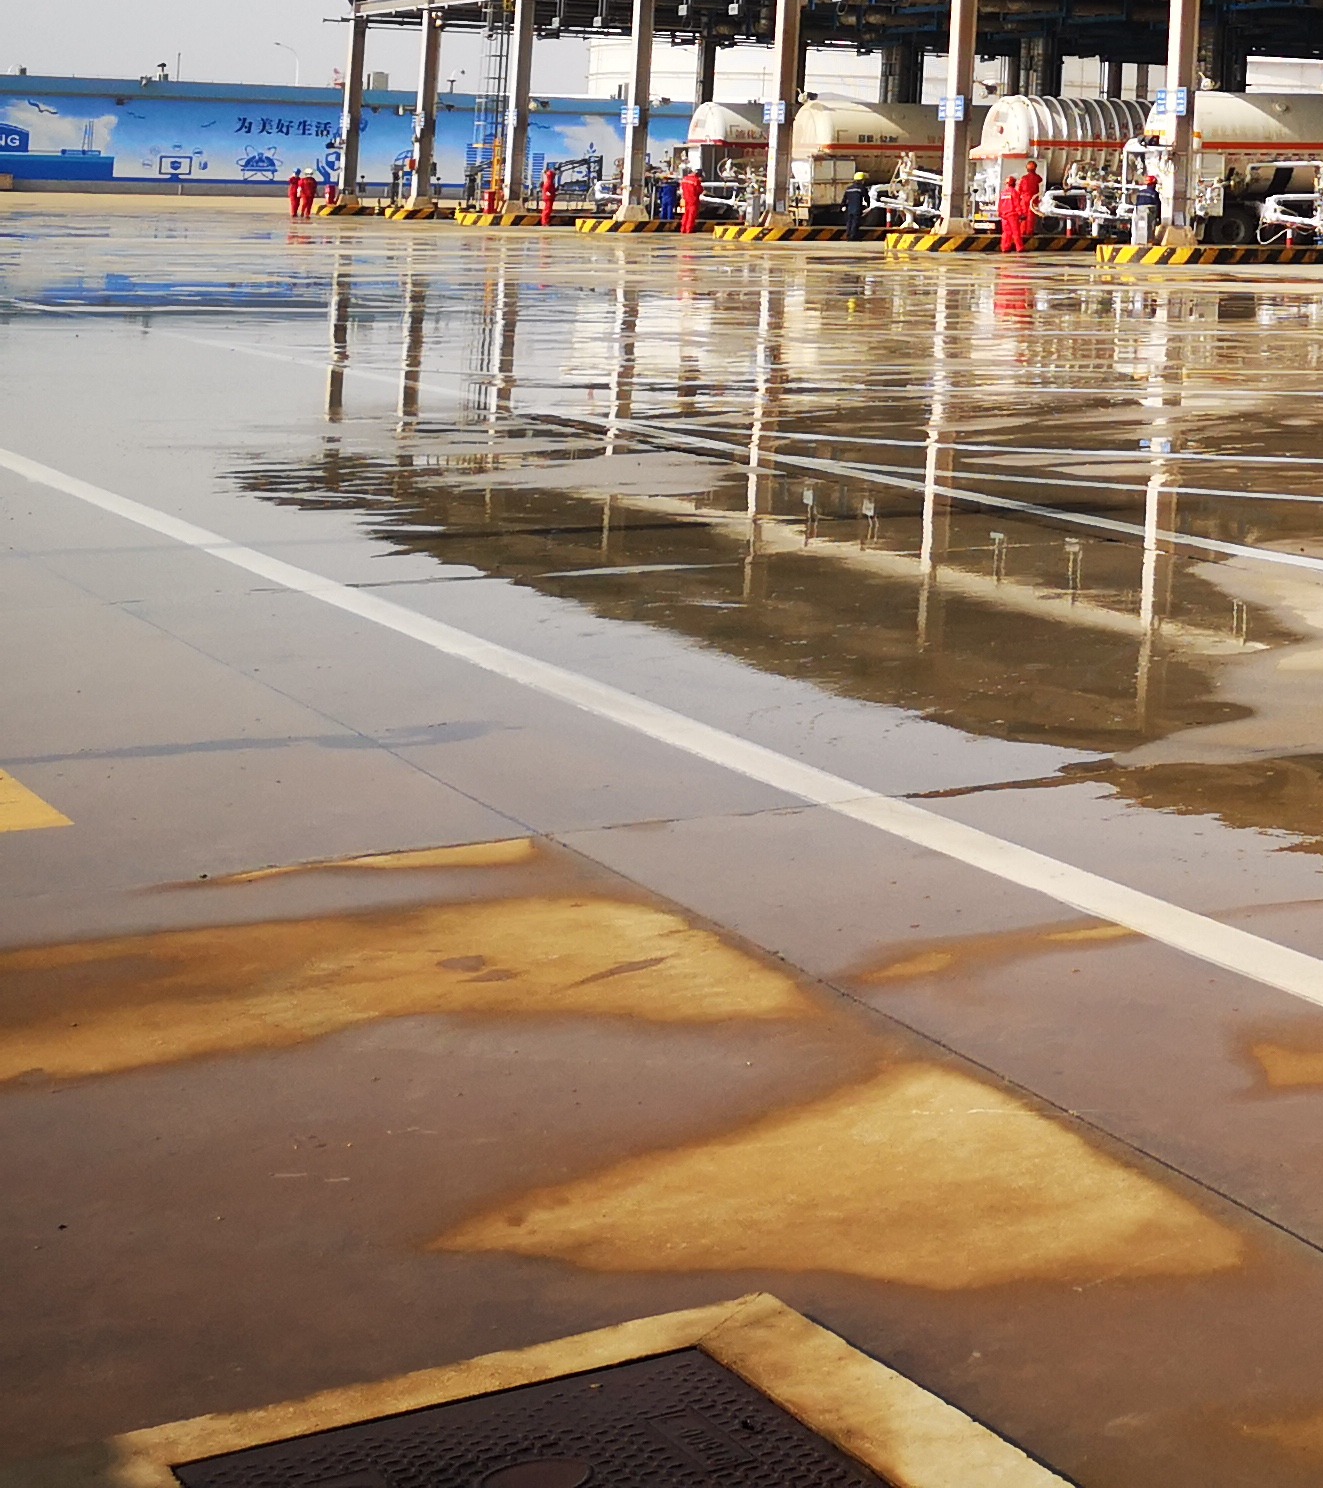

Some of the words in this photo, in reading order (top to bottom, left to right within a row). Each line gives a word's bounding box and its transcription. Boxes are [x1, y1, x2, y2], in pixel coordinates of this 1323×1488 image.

[235, 117, 332, 138] 为美好生活
